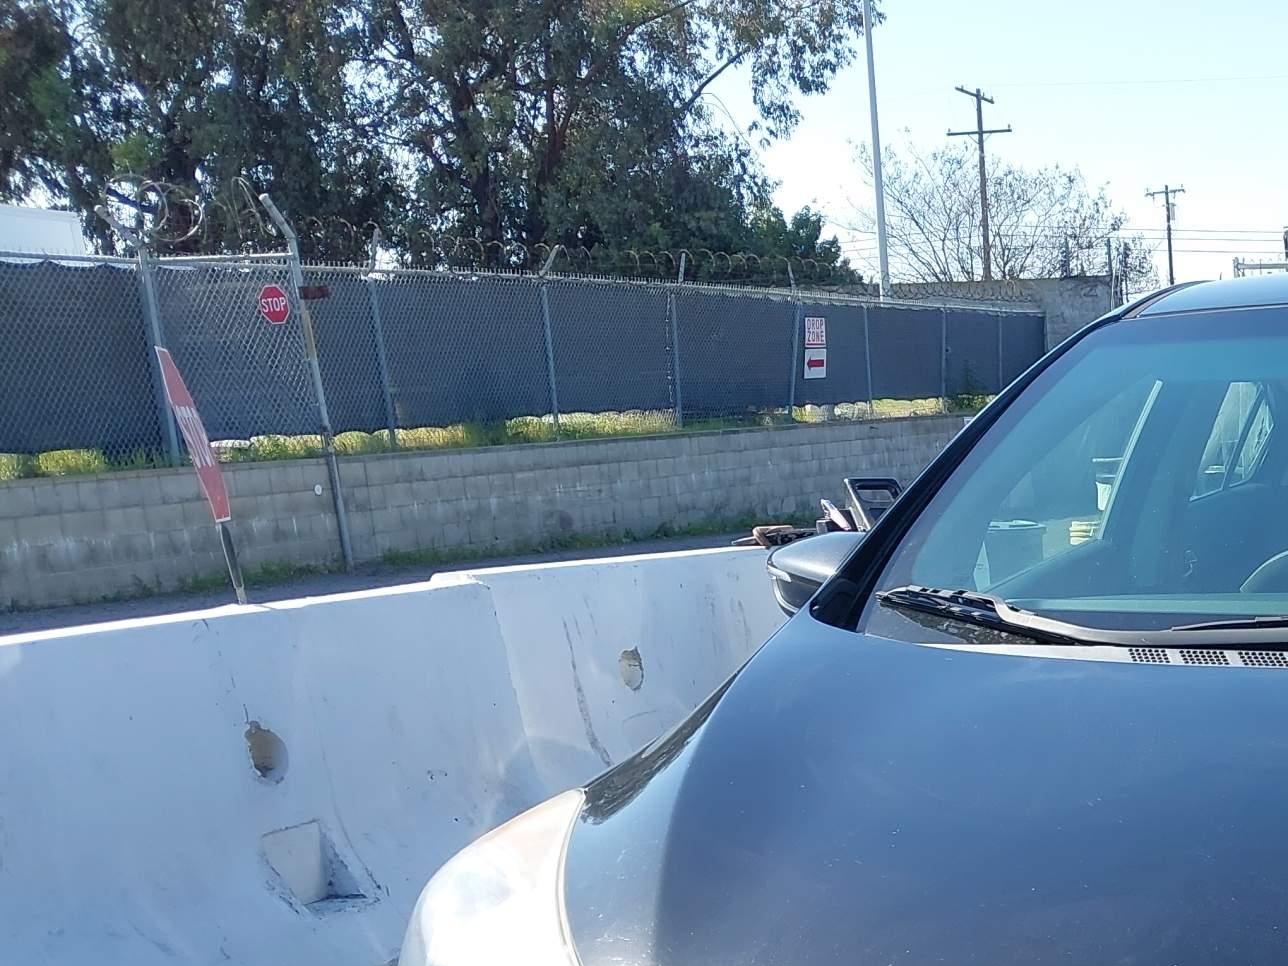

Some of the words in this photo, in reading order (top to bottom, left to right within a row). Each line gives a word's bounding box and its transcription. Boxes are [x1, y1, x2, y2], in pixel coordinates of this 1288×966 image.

[261, 297, 286, 312] STOP
[806, 319, 824, 330] DROP
[807, 330, 825, 342] ZONE
